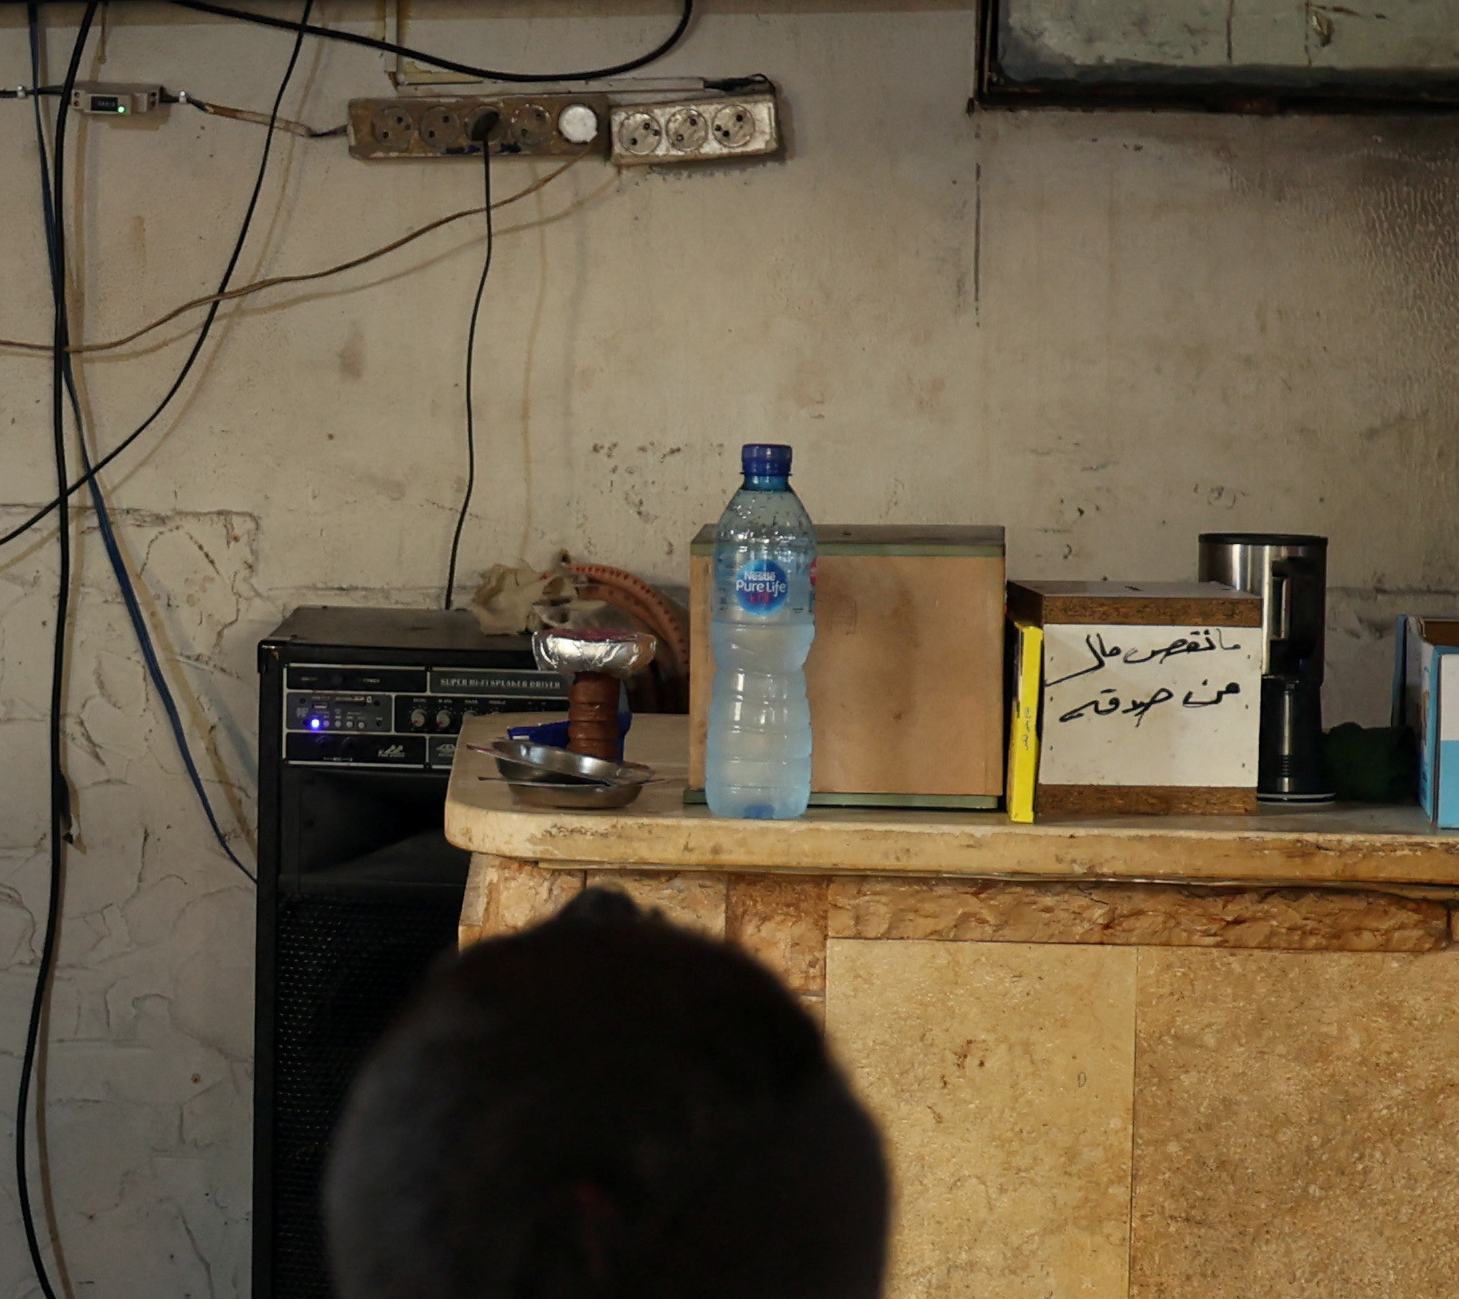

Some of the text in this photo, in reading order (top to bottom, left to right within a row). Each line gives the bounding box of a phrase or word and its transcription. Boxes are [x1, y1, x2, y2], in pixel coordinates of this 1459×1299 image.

[735, 580, 765, 593] Pure
[766, 580, 787, 598] Life
[440, 677, 468, 687] SUPER
[529, 680, 561, 689] DRIVER
[1181, 678, 1242, 709] من
